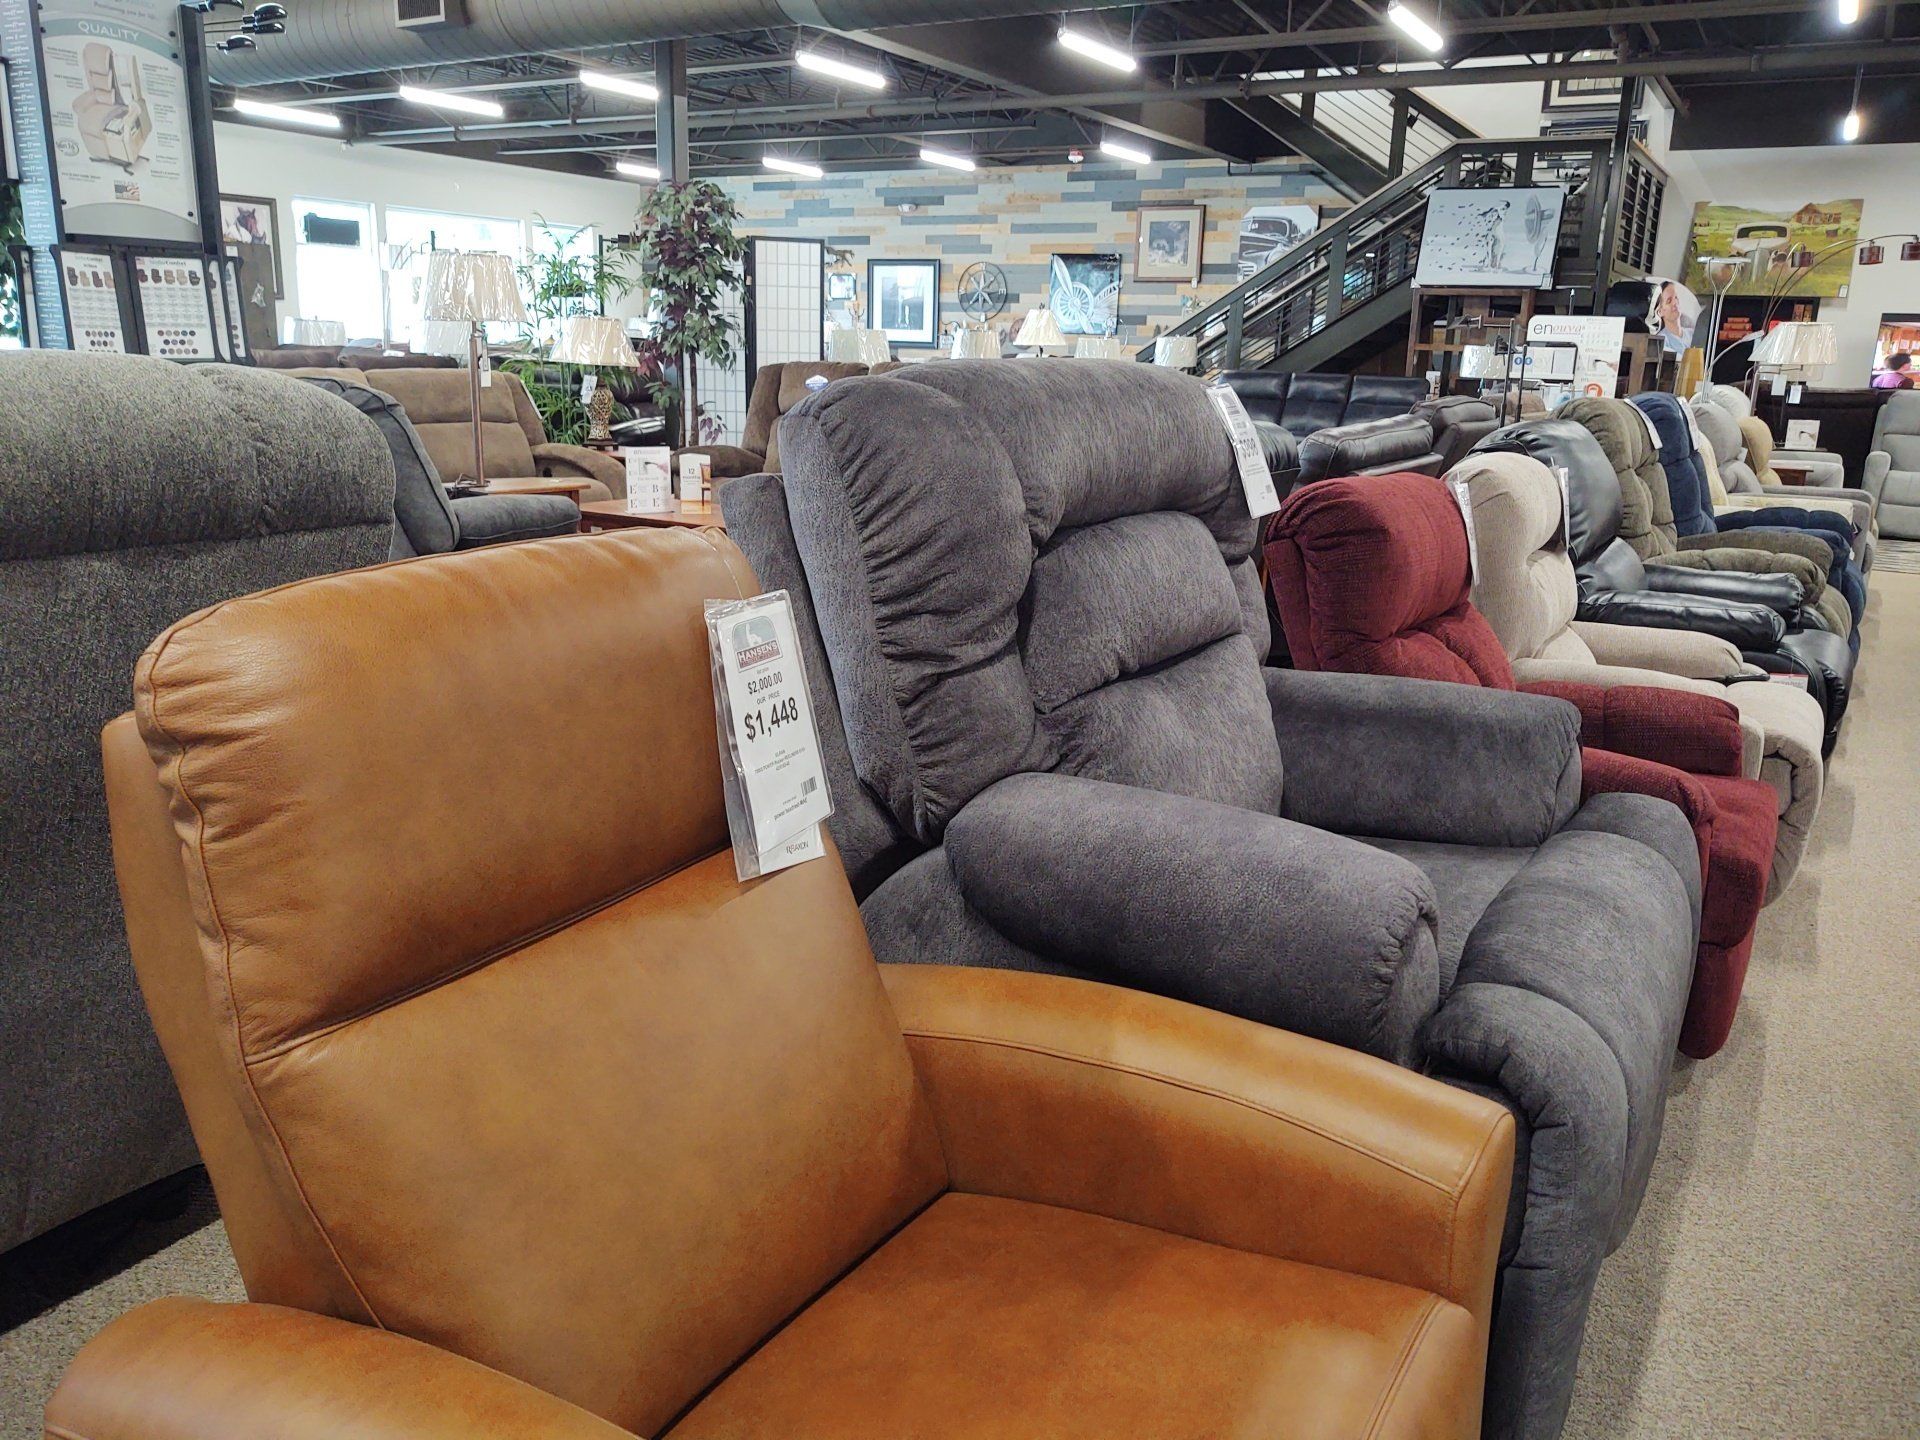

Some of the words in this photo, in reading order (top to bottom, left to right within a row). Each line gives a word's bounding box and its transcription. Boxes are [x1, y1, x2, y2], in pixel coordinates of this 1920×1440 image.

[78, 20, 140, 41] QUALITY
[747, 671, 783, 695] $2,000.00
[756, 696, 766, 704] OUR
[768, 690, 781, 700] PRICE
[744, 696, 798, 743] $1,448
